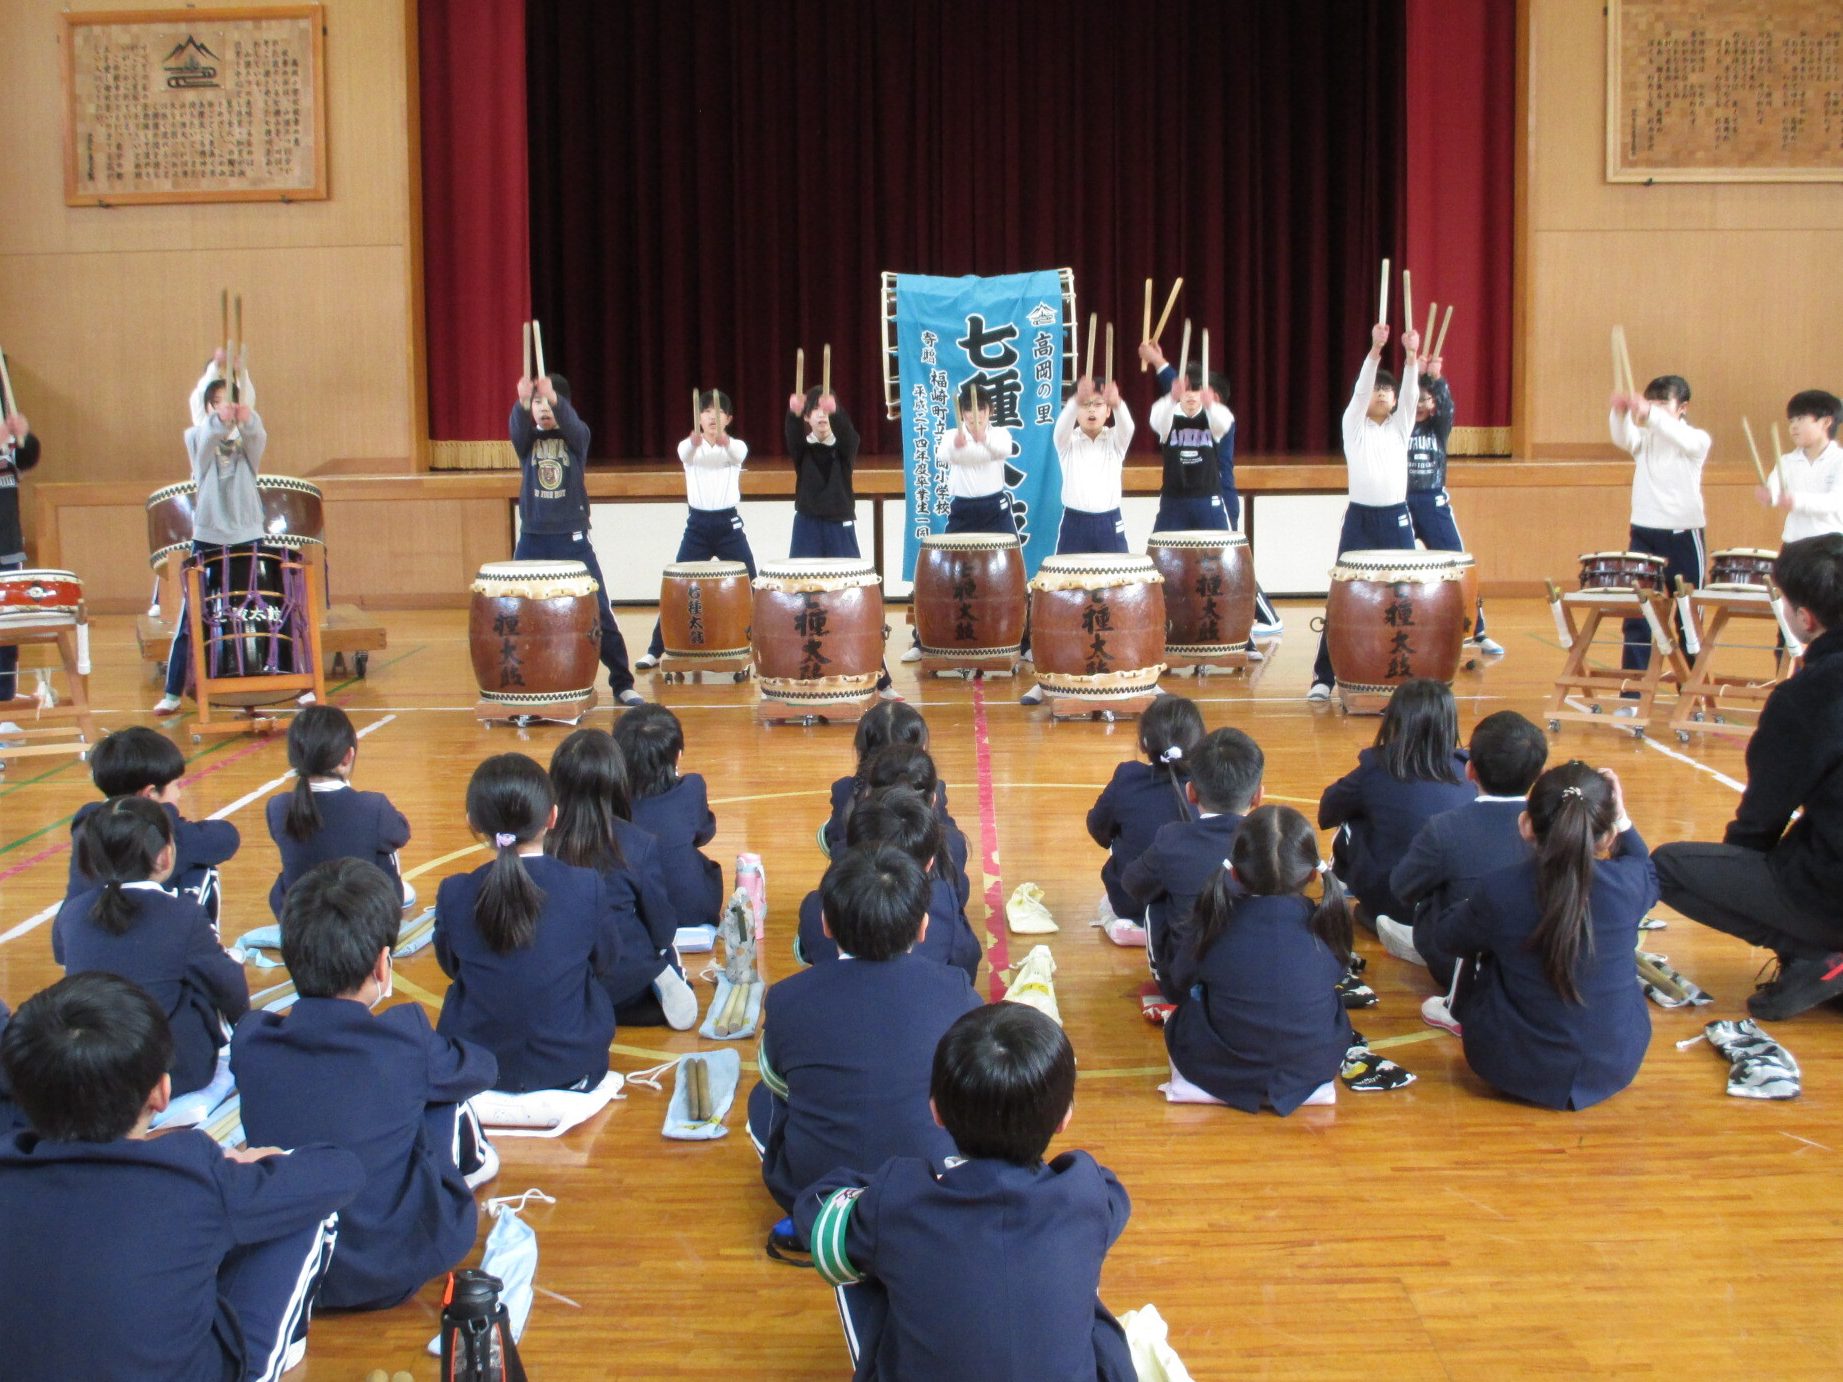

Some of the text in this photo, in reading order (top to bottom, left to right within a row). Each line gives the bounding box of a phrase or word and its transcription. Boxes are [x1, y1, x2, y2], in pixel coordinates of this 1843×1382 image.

[920, 331, 938, 364] 寄贈
[1033, 332, 1055, 424] 高岡の里
[913, 384, 931, 538] 平成二十四年度卒業生一同
[931, 370, 950, 515] 福崎町立岡小学校
